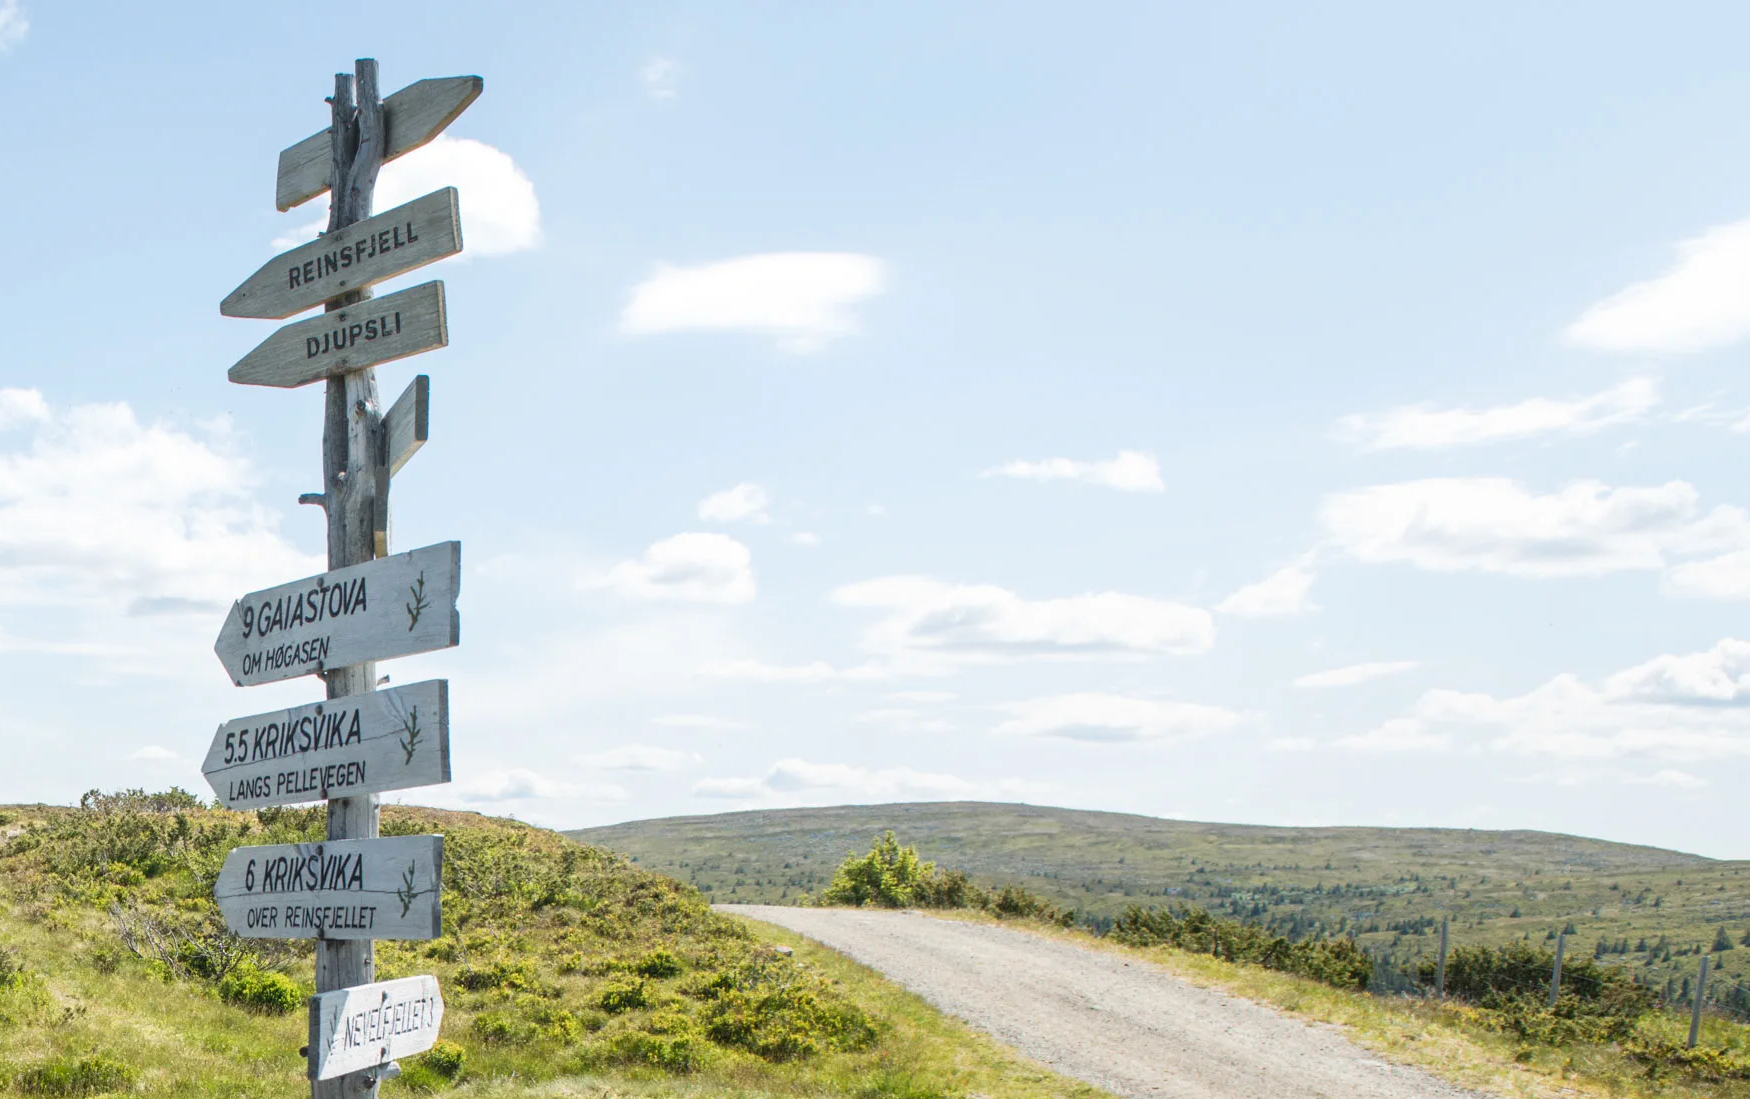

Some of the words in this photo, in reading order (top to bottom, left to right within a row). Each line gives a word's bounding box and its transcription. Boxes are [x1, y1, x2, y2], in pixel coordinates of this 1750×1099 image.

[288, 222, 419, 290] REINSFJELL
[306, 311, 401, 359] DJUPSLI
[242, 606, 255, 639] 9
[257, 577, 367, 637] GAIASTOVA
[242, 651, 263, 675] OM
[265, 635, 330, 671] HØGASEN
[224, 726, 249, 764] 5.5
[252, 708, 362, 762] KRIKSVIKA
[229, 775, 271, 800] LANGS
[277, 761, 366, 795] PELLEVEGEN
[245, 860, 256, 892] 6
[263, 854, 363, 892] KRIKSVIKA
[247, 906, 278, 929] OVER
[284, 906, 377, 929] REINSFJELLET
[344, 998, 426, 1051] NEVELFJELLET
